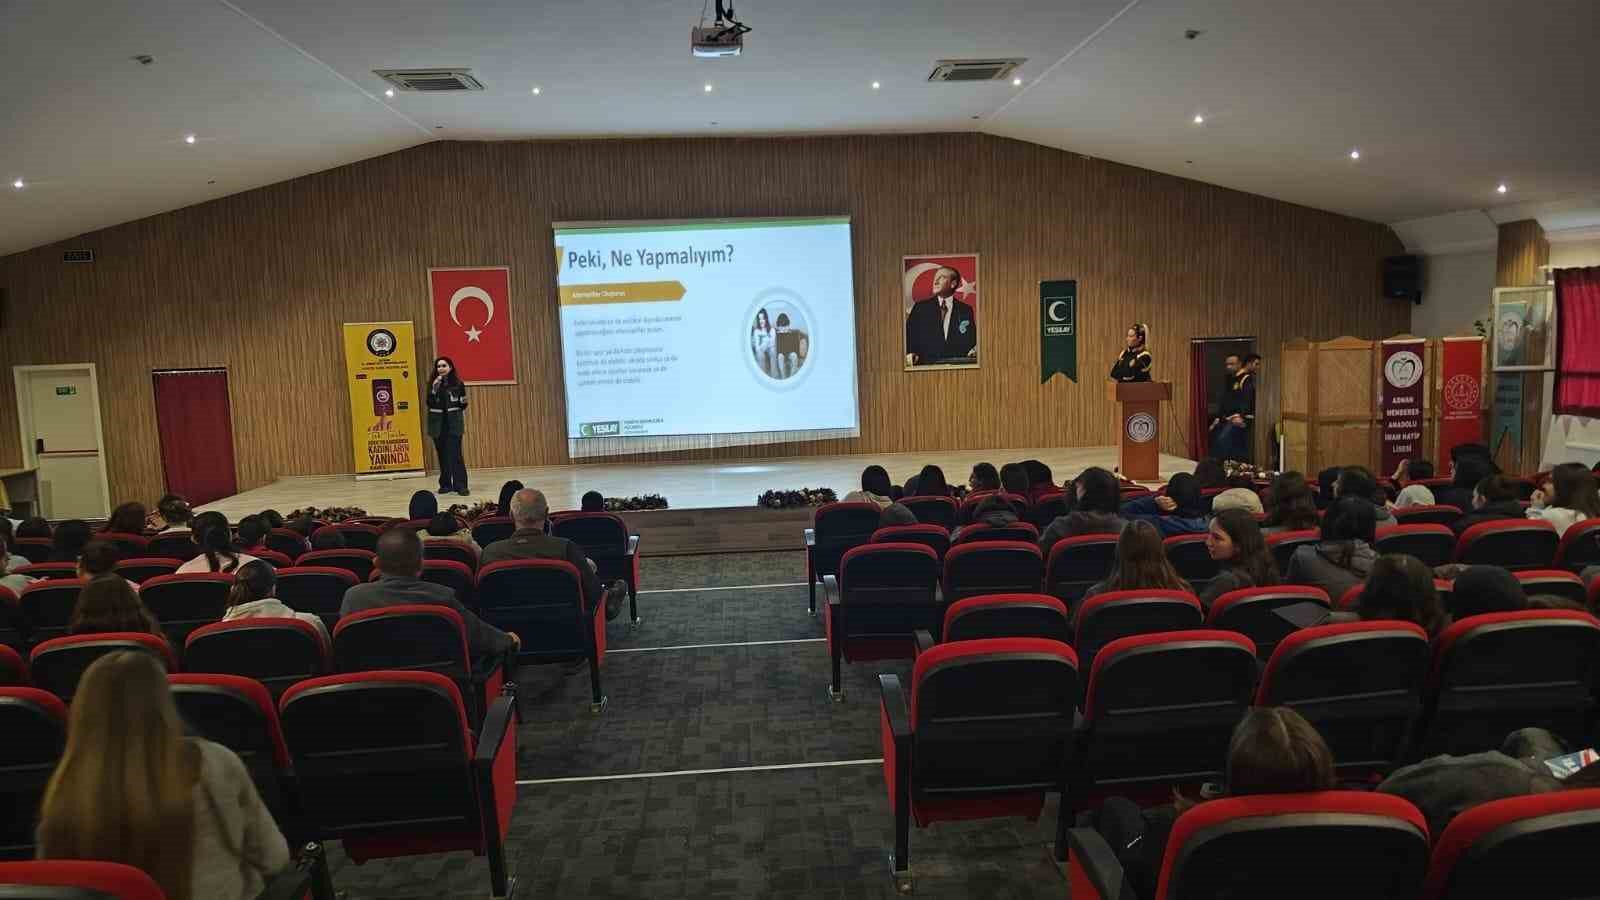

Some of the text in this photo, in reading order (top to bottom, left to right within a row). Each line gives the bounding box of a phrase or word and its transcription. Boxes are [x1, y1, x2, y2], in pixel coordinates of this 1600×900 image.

[568, 244, 734, 270] Peki, Ne Yapmalıyım?
[1386, 408, 1419, 416] MENDERES
[1388, 420, 1417, 428] ANADOLU
[369, 453, 410, 465] YANINDA
